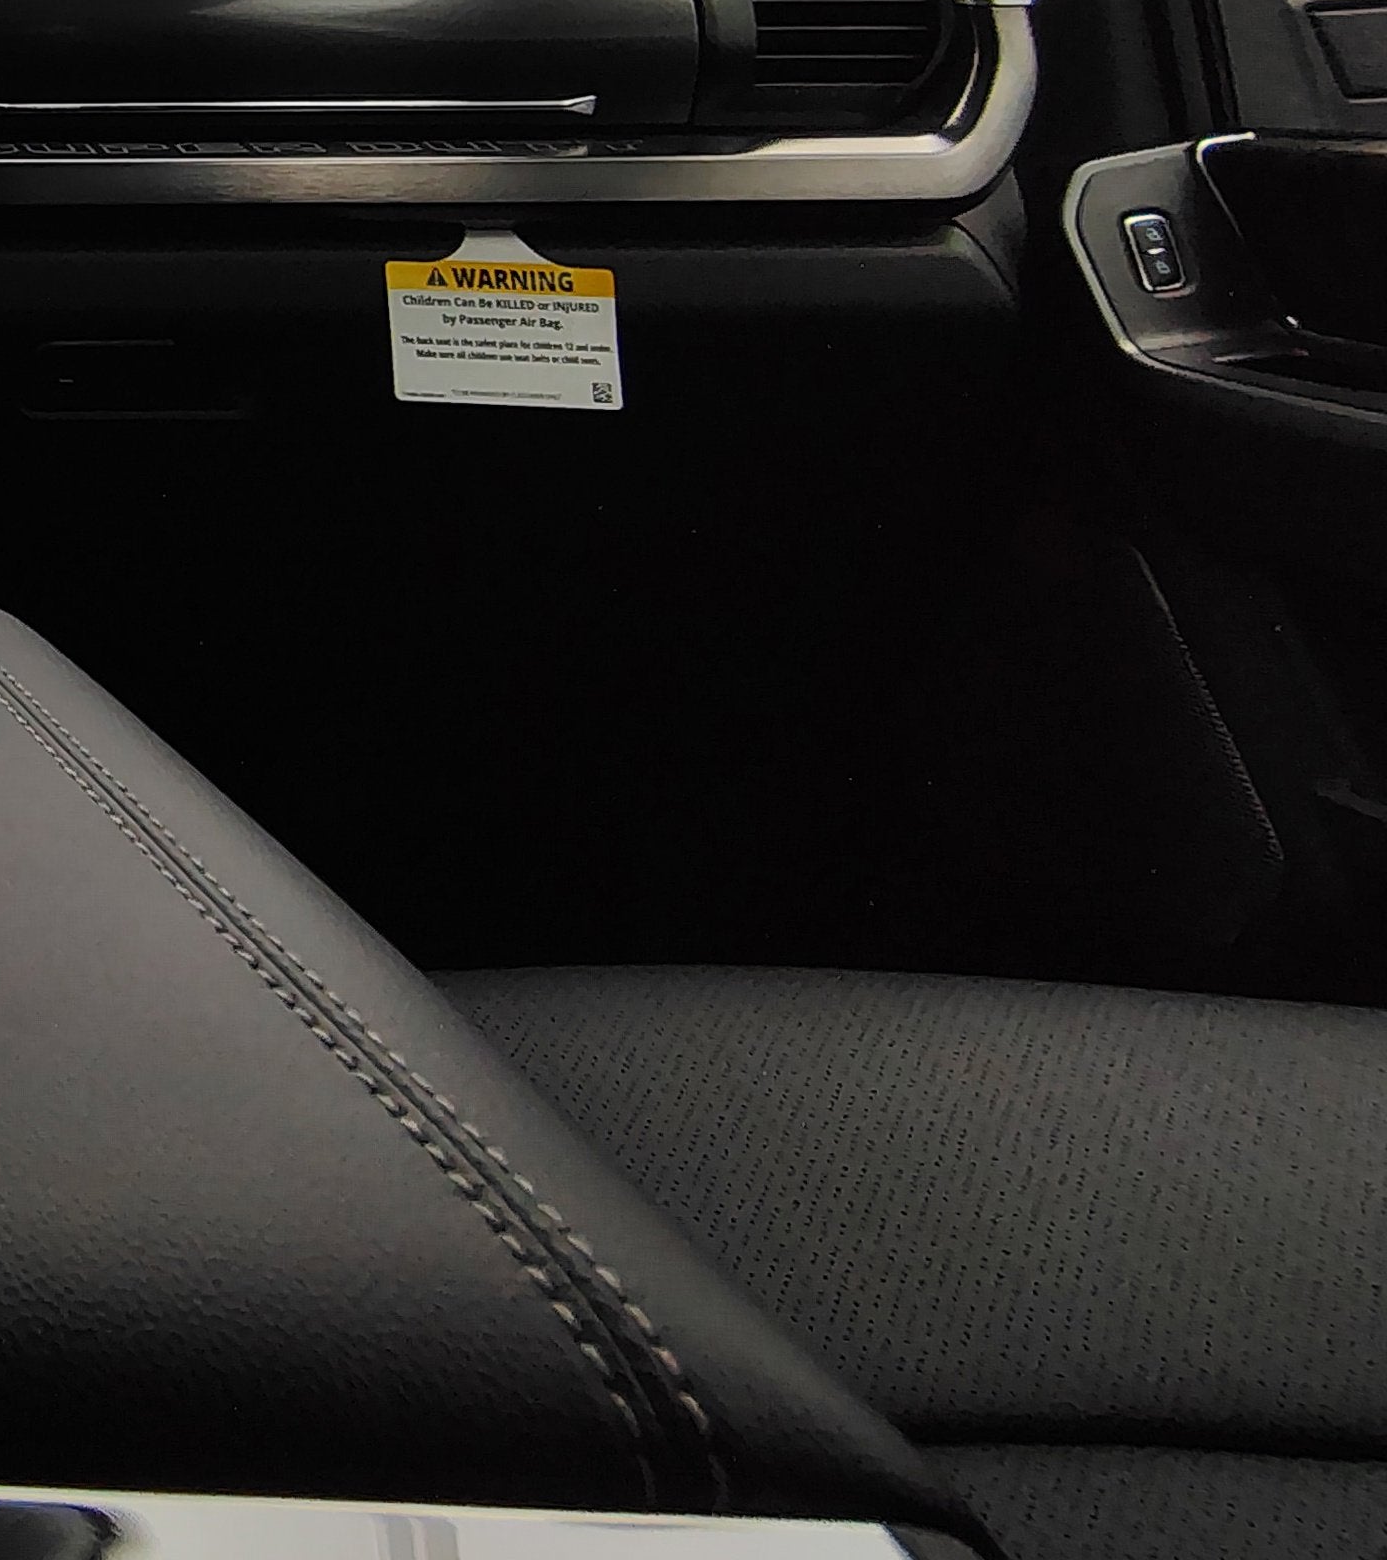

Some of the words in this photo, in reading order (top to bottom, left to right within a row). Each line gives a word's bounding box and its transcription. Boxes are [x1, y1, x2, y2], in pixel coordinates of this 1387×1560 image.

[452, 268, 573, 292] WARNING
[403, 295, 452, 307] Children
[454, 297, 475, 308] Can
[479, 298, 492, 309] Be
[496, 299, 535, 311] KILLED
[537, 302, 551, 311] or
[553, 301, 599, 314] INJURED
[443, 314, 456, 326] by
[459, 315, 517, 329] Passenger
[519, 317, 536, 328] Air
[539, 318, 563, 331] Bag.
